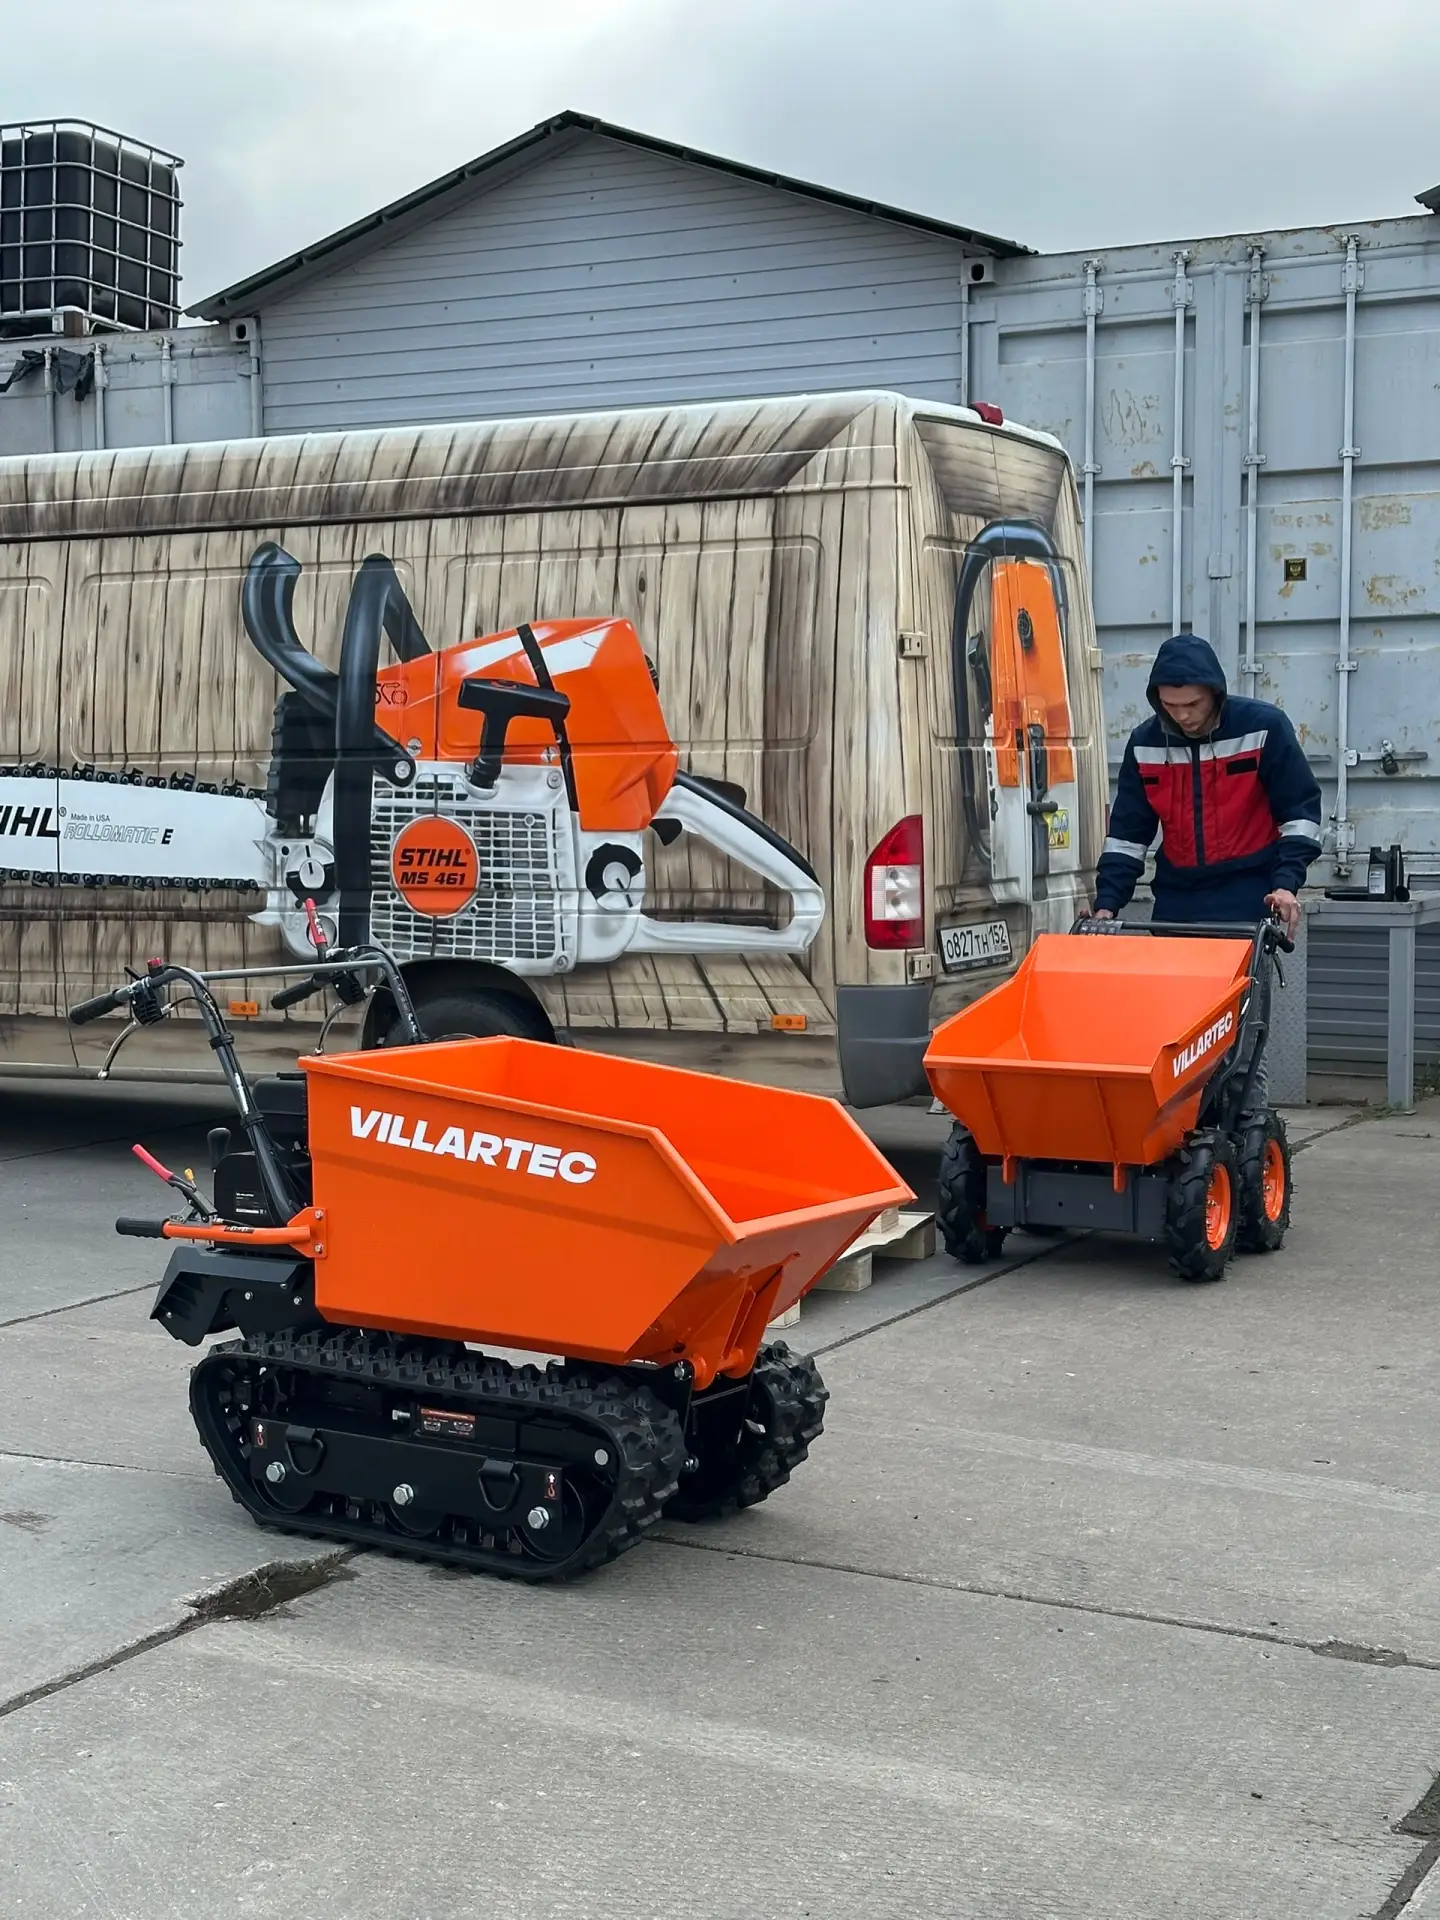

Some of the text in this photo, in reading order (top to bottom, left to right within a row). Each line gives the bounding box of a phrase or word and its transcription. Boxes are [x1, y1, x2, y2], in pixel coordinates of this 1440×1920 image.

[0, 805, 60, 838] IHL
[70, 813, 110, 822] Made in USA
[64, 823, 174, 845] ROLLOMATIC E
[399, 848, 467, 867] STIHL
[400, 872, 466, 885] MS 461
[1173, 1011, 1233, 1078] VILLARTEC
[349, 1105, 597, 1184] VILLARTEC
